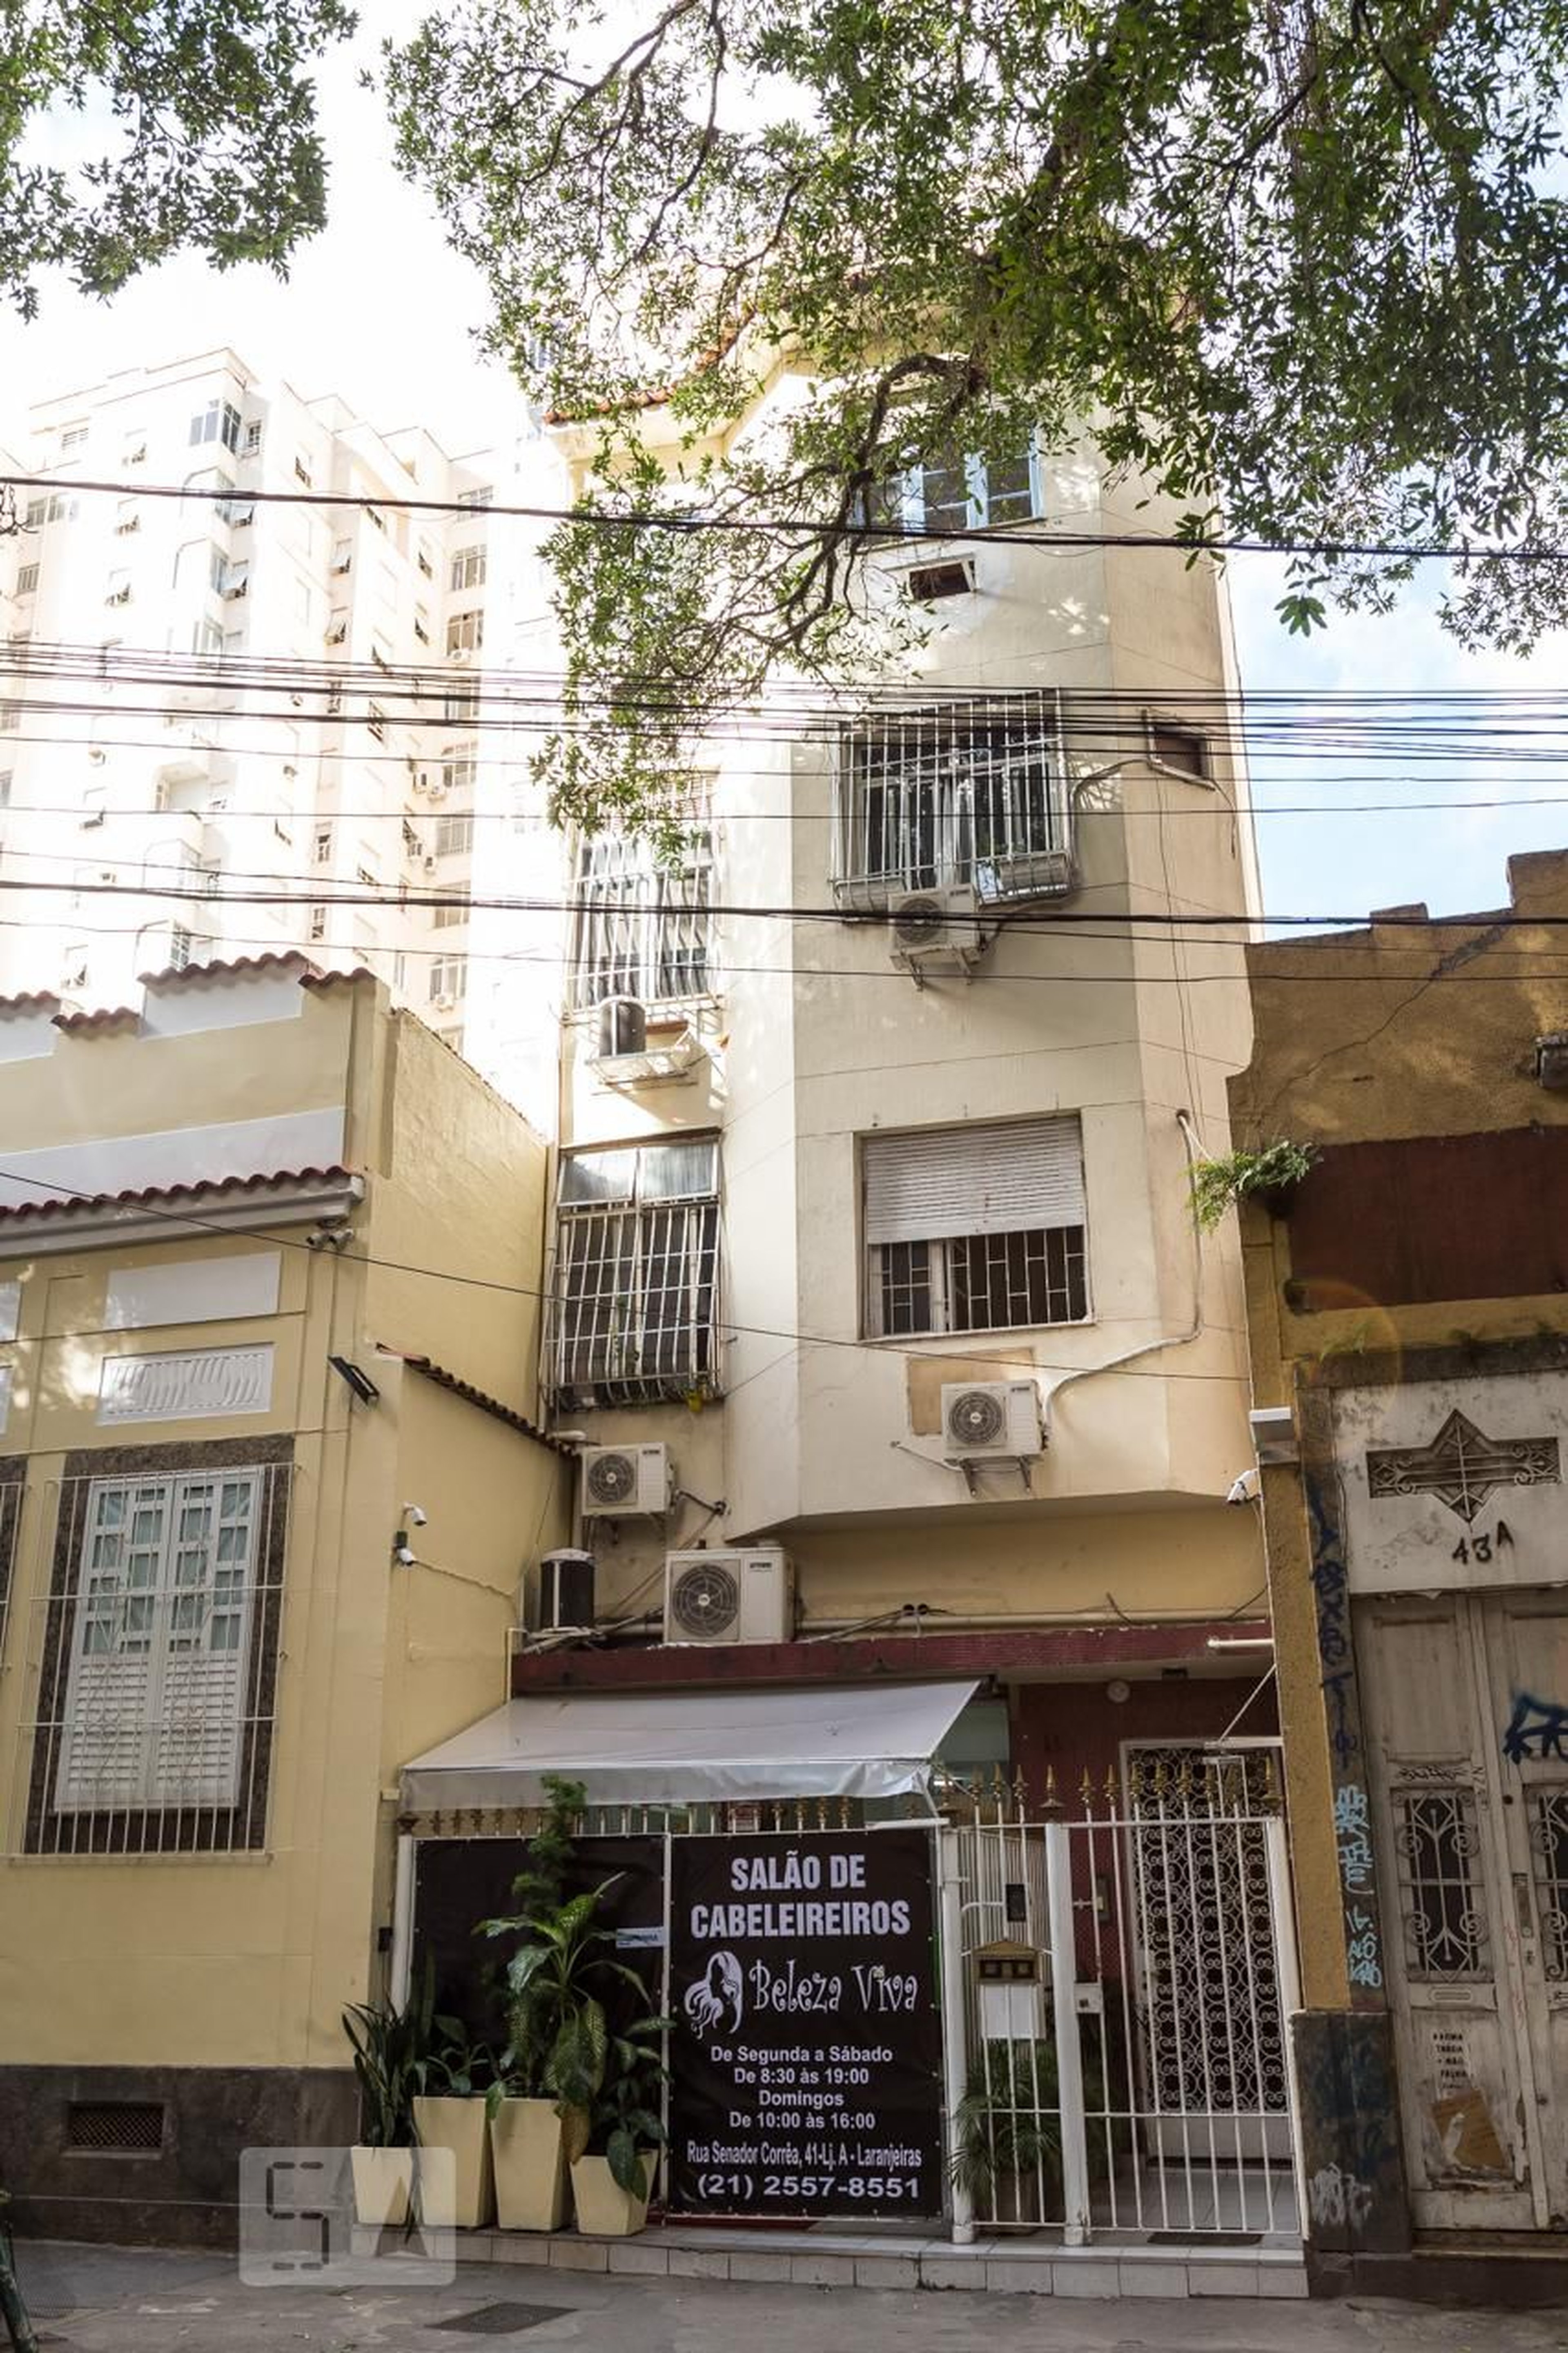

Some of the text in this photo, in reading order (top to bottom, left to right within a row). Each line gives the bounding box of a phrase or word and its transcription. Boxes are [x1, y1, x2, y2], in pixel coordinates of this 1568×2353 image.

[731, 1850, 866, 1891] SALÃO DE
[691, 1900, 911, 1938] CABELEIREIROS
[749, 1959, 918, 2013] Beleza Viva
[711, 2046, 893, 2065] De Segunda a Sábado
[734, 2068, 756, 2083] De
[760, 2068, 795, 2083] 8:30
[825, 2068, 869, 2084] 19:00
[759, 2090, 844, 2110] Domingos
[730, 2111, 751, 2128] De
[757, 2112, 801, 2128] 10:00
[831, 2112, 875, 2129] 16:00
[688, 2140, 709, 2163] Rua
[712, 2140, 758, 2164] Senador
[838, 2143, 848, 2165] A
[858, 2143, 922, 2172] Laranjeiras
[699, 2174, 918, 2199] (21) 2557-8551
